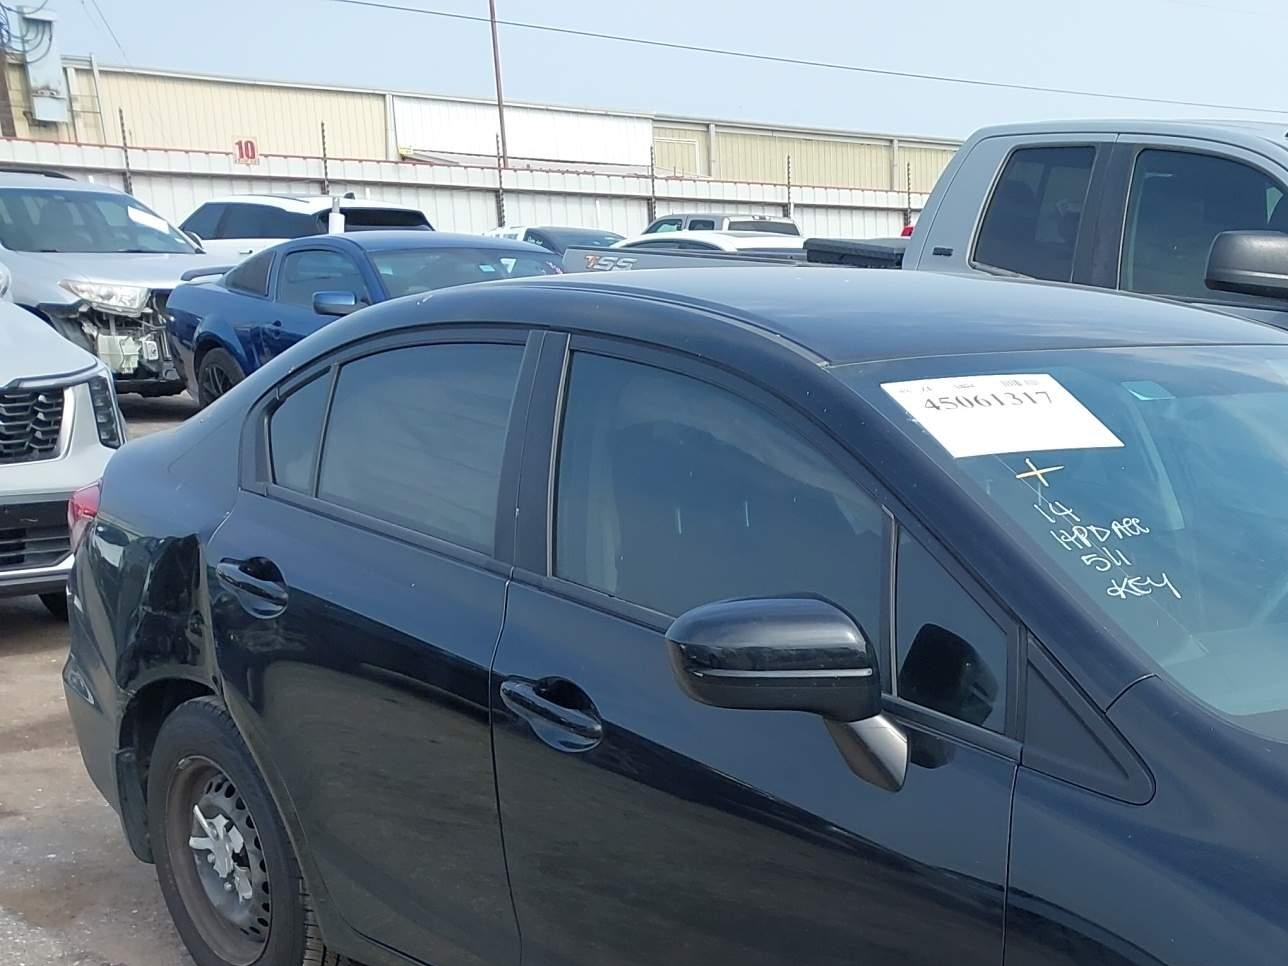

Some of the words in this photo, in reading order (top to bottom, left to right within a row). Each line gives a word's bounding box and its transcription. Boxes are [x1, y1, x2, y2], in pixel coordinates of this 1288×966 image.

[234, 140, 256, 160] 10
[924, 391, 1052, 410] 45061317
[1033, 501, 1081, 523] 14
